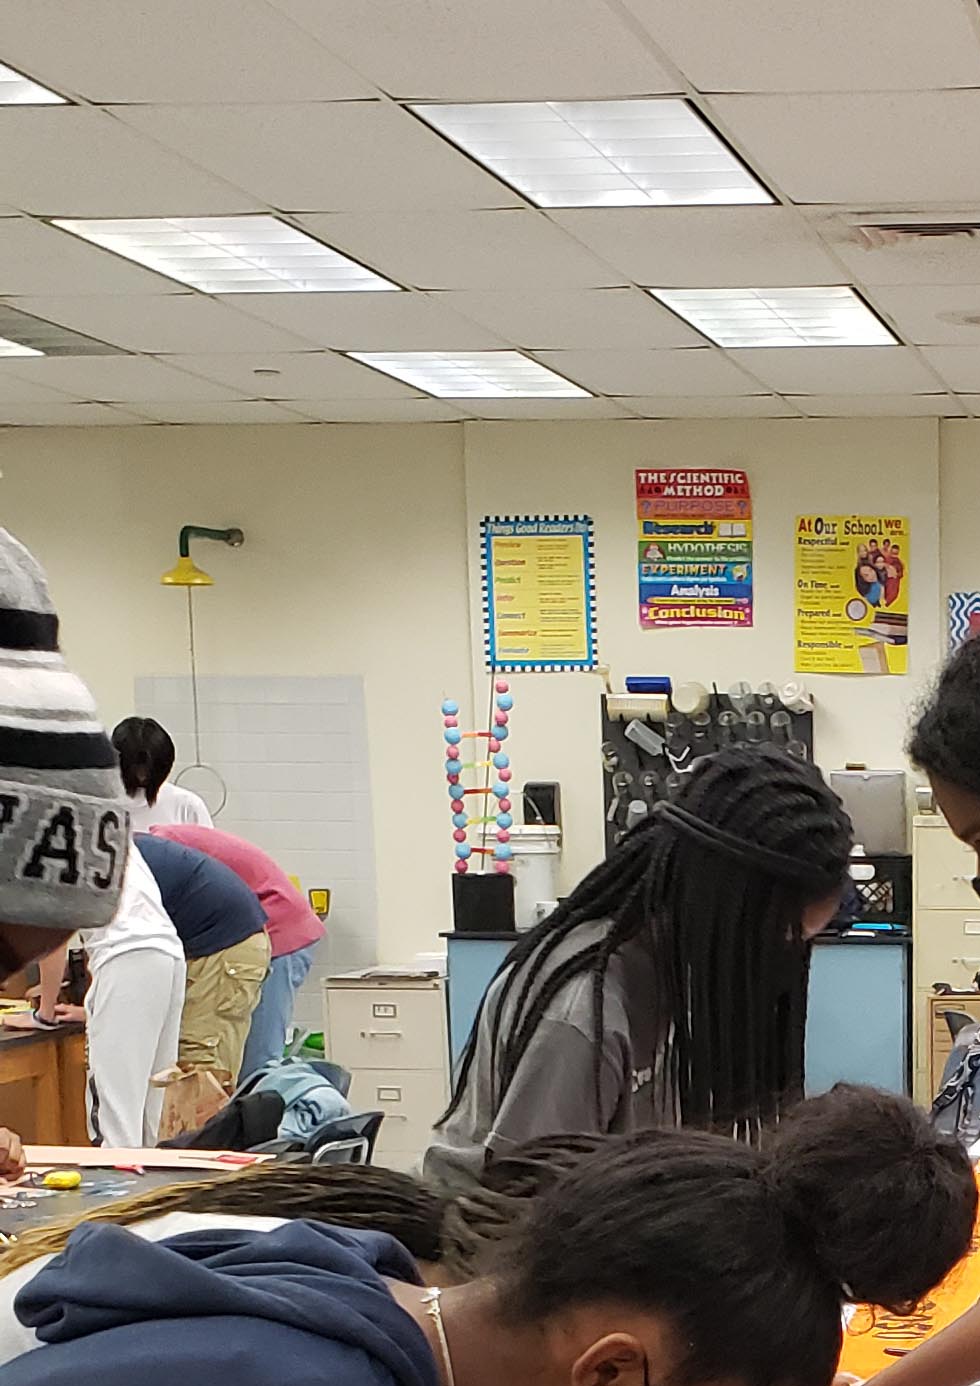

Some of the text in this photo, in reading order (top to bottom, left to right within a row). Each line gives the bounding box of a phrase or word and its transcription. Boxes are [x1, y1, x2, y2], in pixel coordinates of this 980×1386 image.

[638, 472, 744, 484] THE SCIENTIFIC
[663, 485, 724, 497] METHOD
[655, 500, 736, 513] PURPOSE
[488, 523, 514, 535] Things
[515, 523, 538, 533] Good
[643, 520, 715, 535] Research
[798, 517, 902, 536] At Our School we
[798, 536, 838, 547] Respectful
[667, 542, 748, 554] HYPOTHESIS
[641, 563, 727, 576] EXPERIMENT
[670, 584, 720, 598] Analysis
[648, 606, 745, 620] Conclusion
[797, 608, 831, 618] Prepared
[797, 640, 842, 650] Responsible
